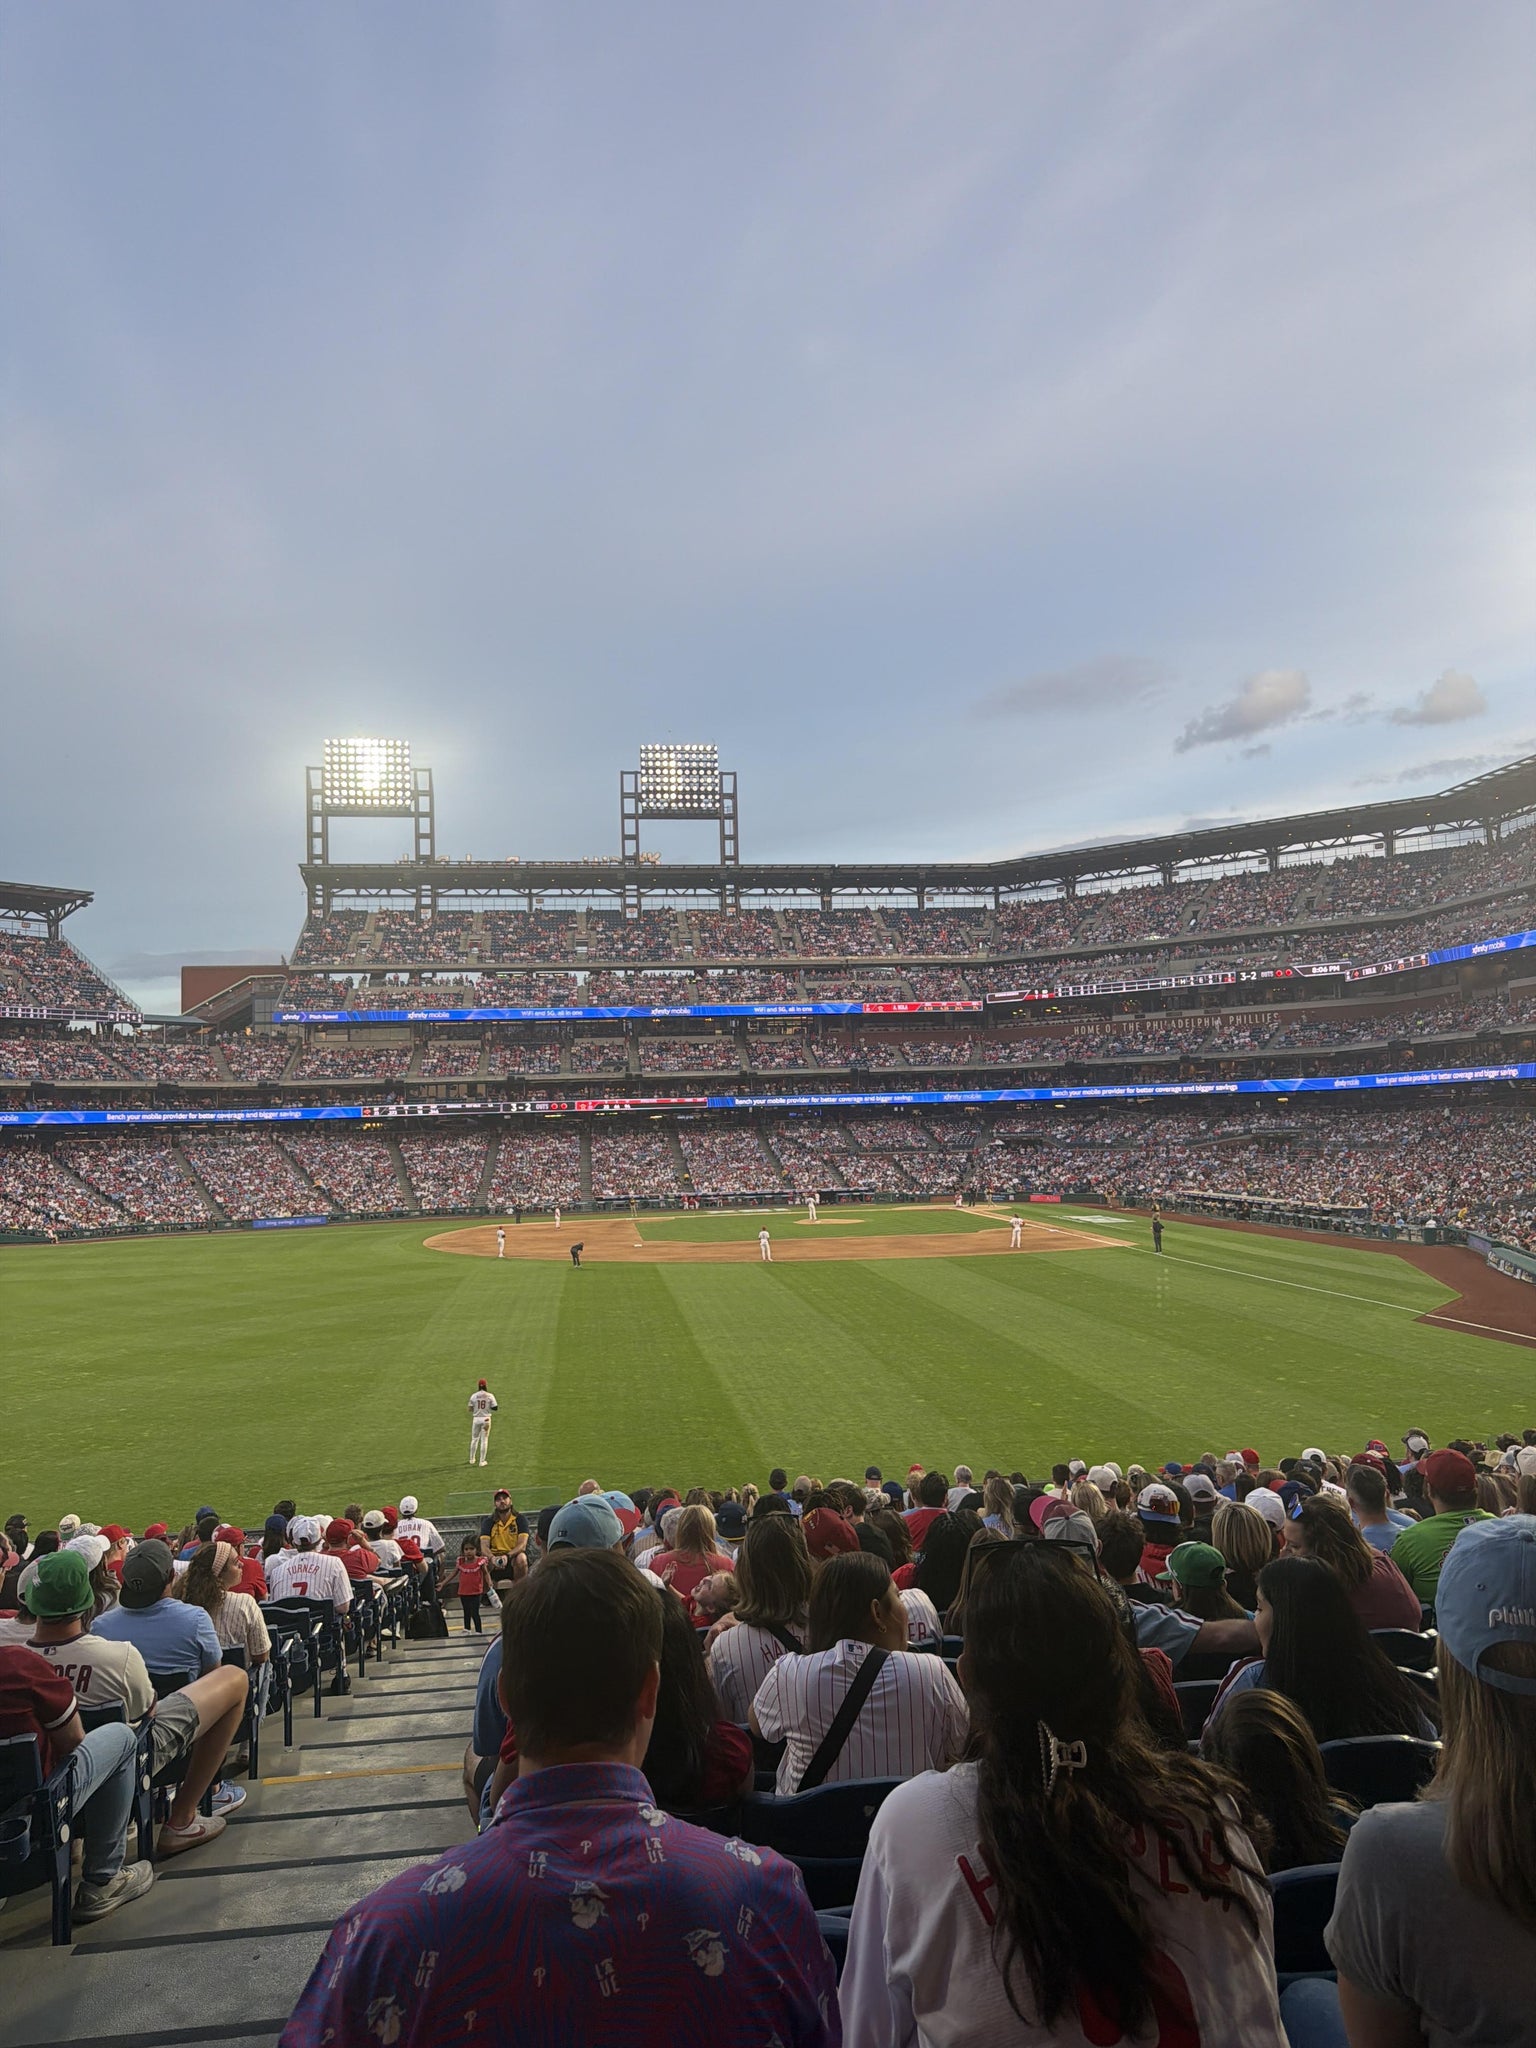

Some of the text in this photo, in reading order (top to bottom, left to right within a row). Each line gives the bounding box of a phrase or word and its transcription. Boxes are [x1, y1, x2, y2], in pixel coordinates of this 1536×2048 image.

[1472, 940, 1506, 954] xfinity mobile
[1311, 966, 1328, 974] 8:06
[283, 1013, 300, 1021] xfinity
[408, 1011, 428, 1020] xfinity
[651, 1007, 670, 1016] xfinity
[1074, 1025, 1101, 1035] HOME
[1122, 1021, 1141, 1032] THE
[1229, 1012, 1280, 1025] PHILLIES
[1452, 1071, 1474, 1080] coverage
[1484, 1068, 1500, 1079] bigger
[1500, 1067, 1519, 1077] savings
[1155, 1086, 1182, 1094] coverage
[1195, 1084, 1215, 1093] bigger
[1216, 1083, 1238, 1092] savings
[787, 1096, 810, 1104] provider
[838, 1096, 863, 1104] coverage
[876, 1094, 893, 1103] bigger
[893, 1094, 913, 1103] savings
[944, 1092, 962, 1101] xfinity
[0, 1114, 19, 1122] obile
[106, 1113, 126, 1121] Bench
[127, 1113, 141, 1122] your
[142, 1112, 162, 1120] mobile
[163, 1112, 188, 1121] provider
[217, 1112, 245, 1120] coverage
[259, 1111, 279, 1120] bigger
[279, 1110, 302, 1119] savings
[398, 1523, 422, 1534] DURAN
[287, 1563, 320, 1576] TURNER
[292, 1581, 308, 1596] 7
